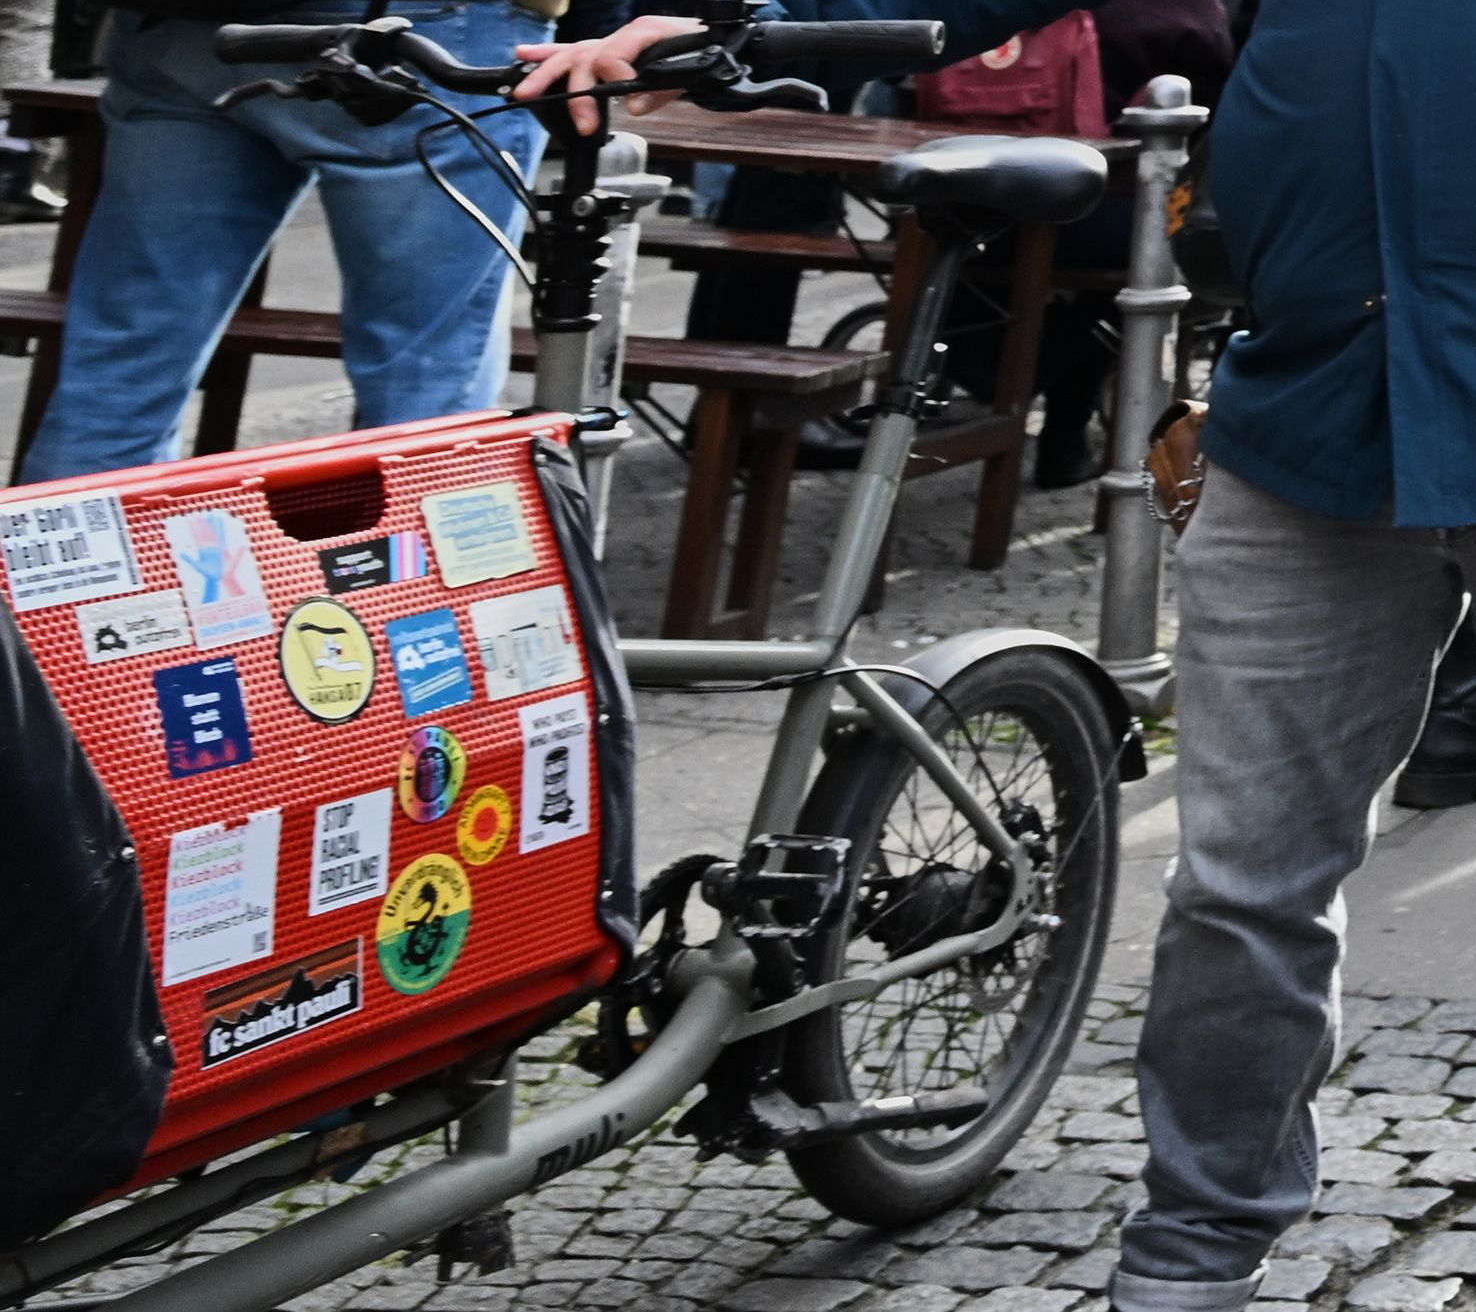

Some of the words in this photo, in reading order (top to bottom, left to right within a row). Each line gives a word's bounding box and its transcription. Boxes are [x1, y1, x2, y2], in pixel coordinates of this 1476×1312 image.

[323, 802, 354, 833] STOP
[321, 831, 360, 864] RACIAL
[318, 855, 381, 895] PROFILING
[209, 1027, 232, 1057] fc
[232, 1003, 296, 1047] sankt
[296, 977, 356, 1030] pauli
[534, 1111, 625, 1185] muli
